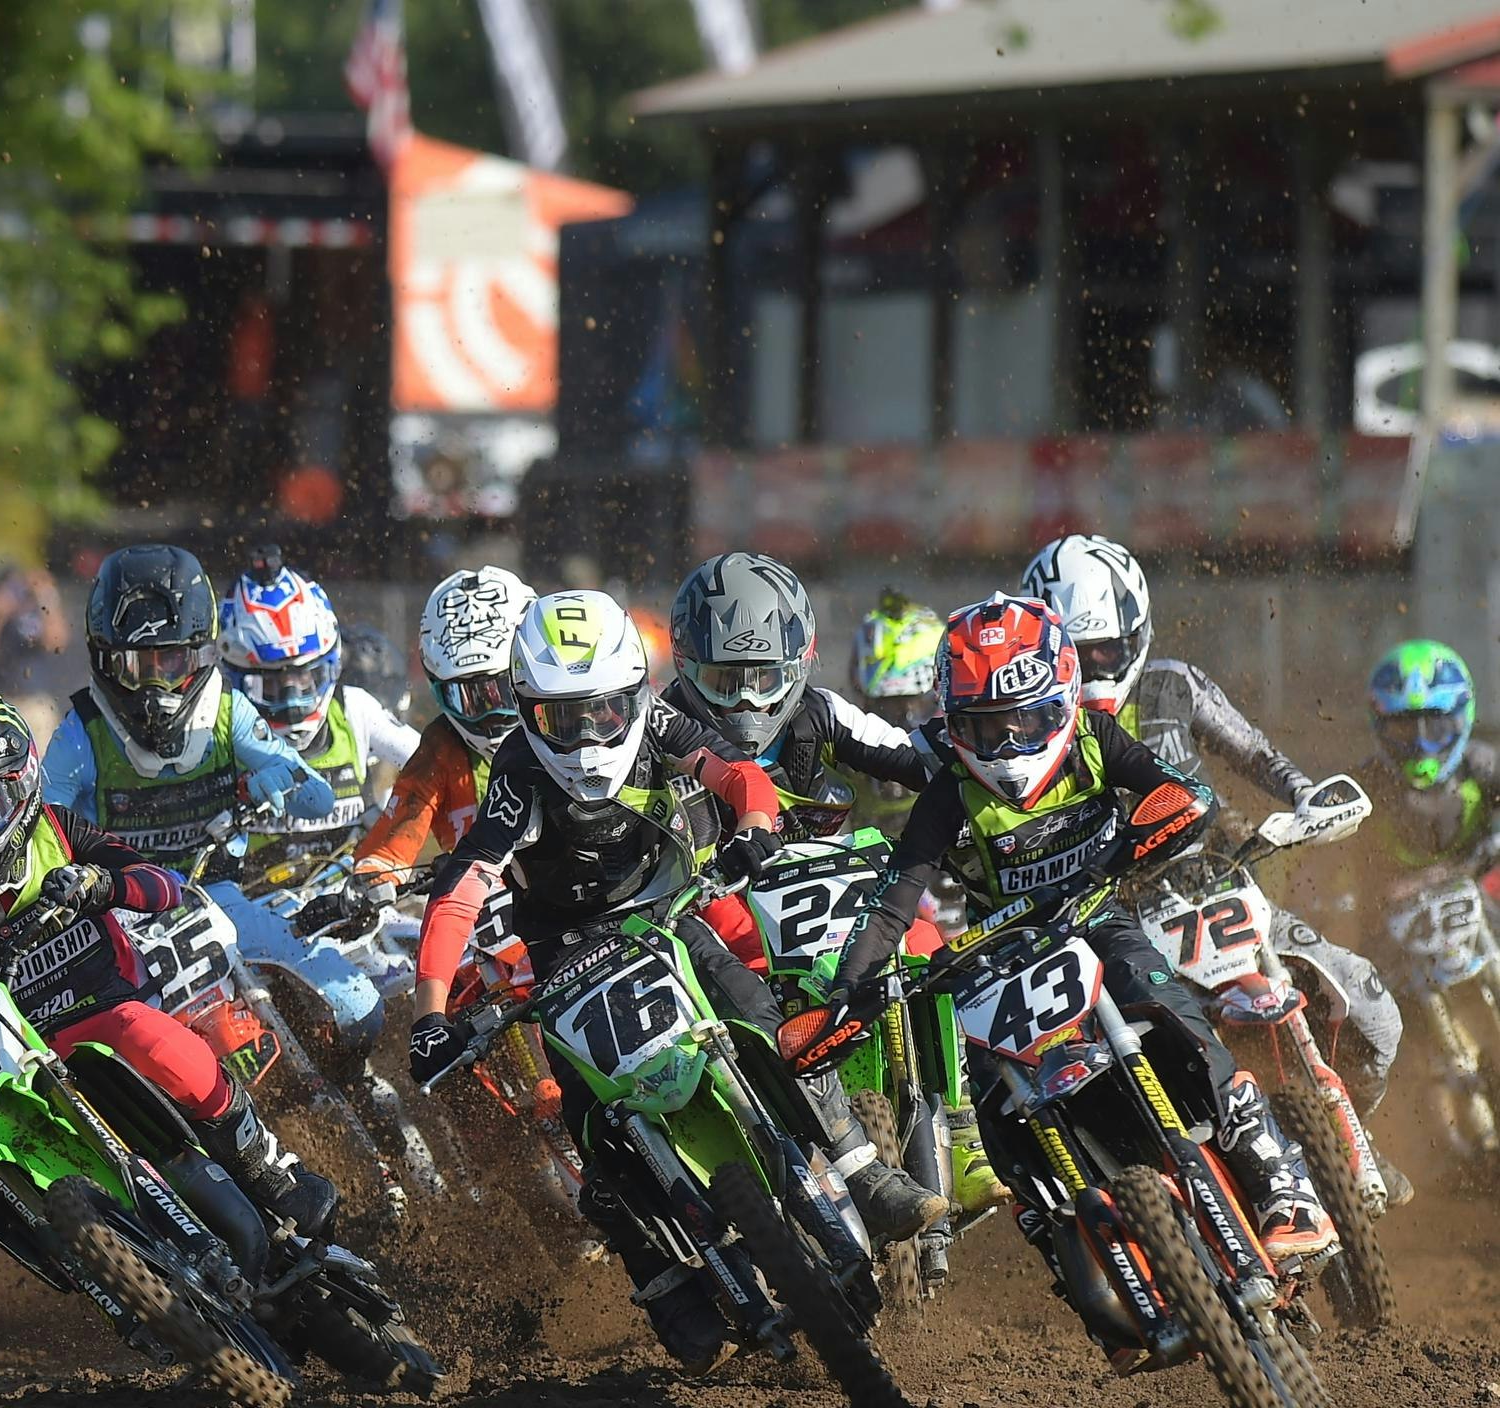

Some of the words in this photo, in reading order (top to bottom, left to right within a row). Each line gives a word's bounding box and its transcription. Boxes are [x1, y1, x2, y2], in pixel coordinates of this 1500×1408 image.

[554, 595, 591, 648] FOX
[980, 628, 1004, 643] PPG
[459, 655, 486, 667] BELL
[1008, 843, 1090, 891] CHAMPI
[781, 878, 878, 955] 24
[1161, 898, 1260, 967] 72
[13, 922, 93, 987] PIONSHIP
[572, 957, 679, 1077] 16
[988, 951, 1086, 1053] 43
[647, 1155, 674, 1194] CIRCU
[1043, 1127, 1087, 1190] Factory
[136, 1175, 201, 1237] DUNLOP
[1195, 1177, 1243, 1252] DUNLOP
[78, 1279, 123, 1318] NLOP
[1108, 1241, 1157, 1321] DUNLOP
